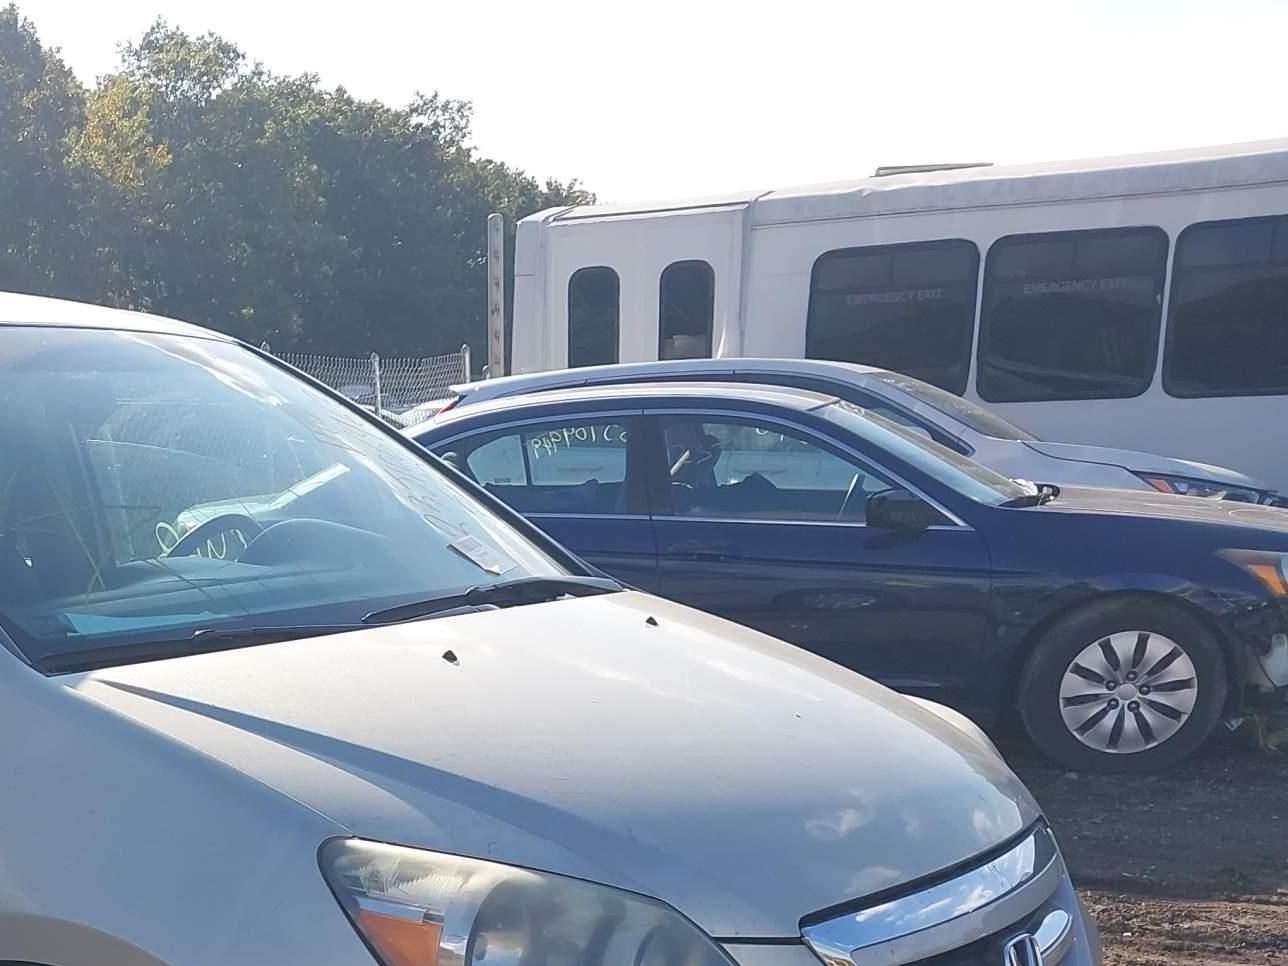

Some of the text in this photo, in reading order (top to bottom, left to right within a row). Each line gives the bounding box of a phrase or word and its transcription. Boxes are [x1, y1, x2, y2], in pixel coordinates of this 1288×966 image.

[1024, 277, 1126, 294] EMERGENCY EXIT
[846, 287, 943, 305] EMERGENCY EXIT
